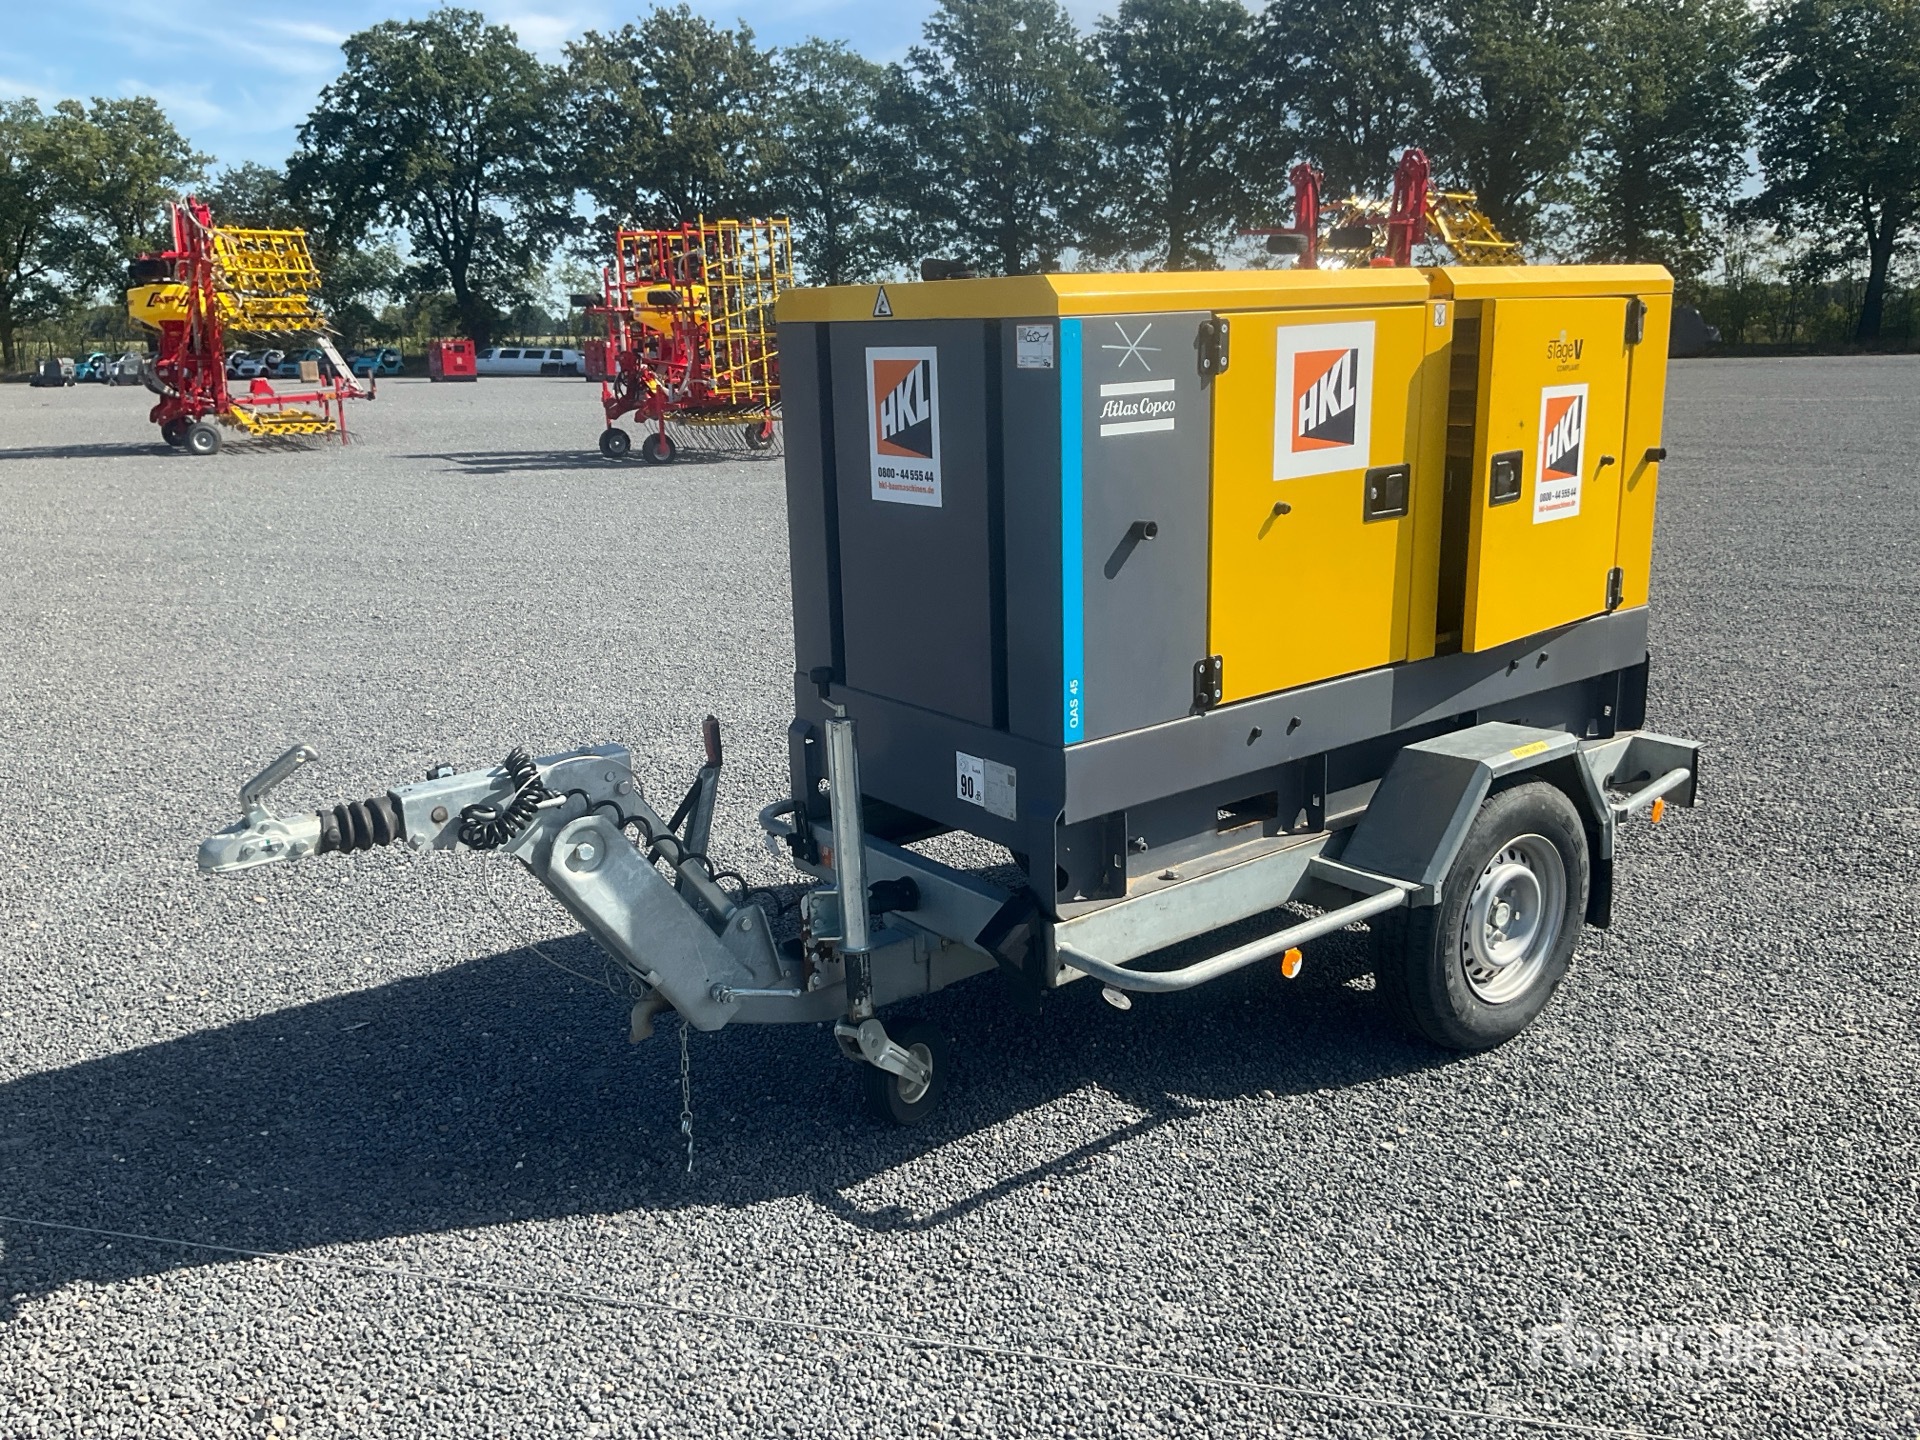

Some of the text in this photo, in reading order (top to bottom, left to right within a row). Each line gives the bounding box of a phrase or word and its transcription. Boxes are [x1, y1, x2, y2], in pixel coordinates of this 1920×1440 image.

[880, 360, 930, 440] HKL
[1100, 397, 1176, 418] Atlas Copco
[1298, 349, 1356, 437] HKL
[1546, 395, 1580, 470] HKL
[1069, 679, 1079, 729] QAS 45
[961, 774, 974, 799] 90
